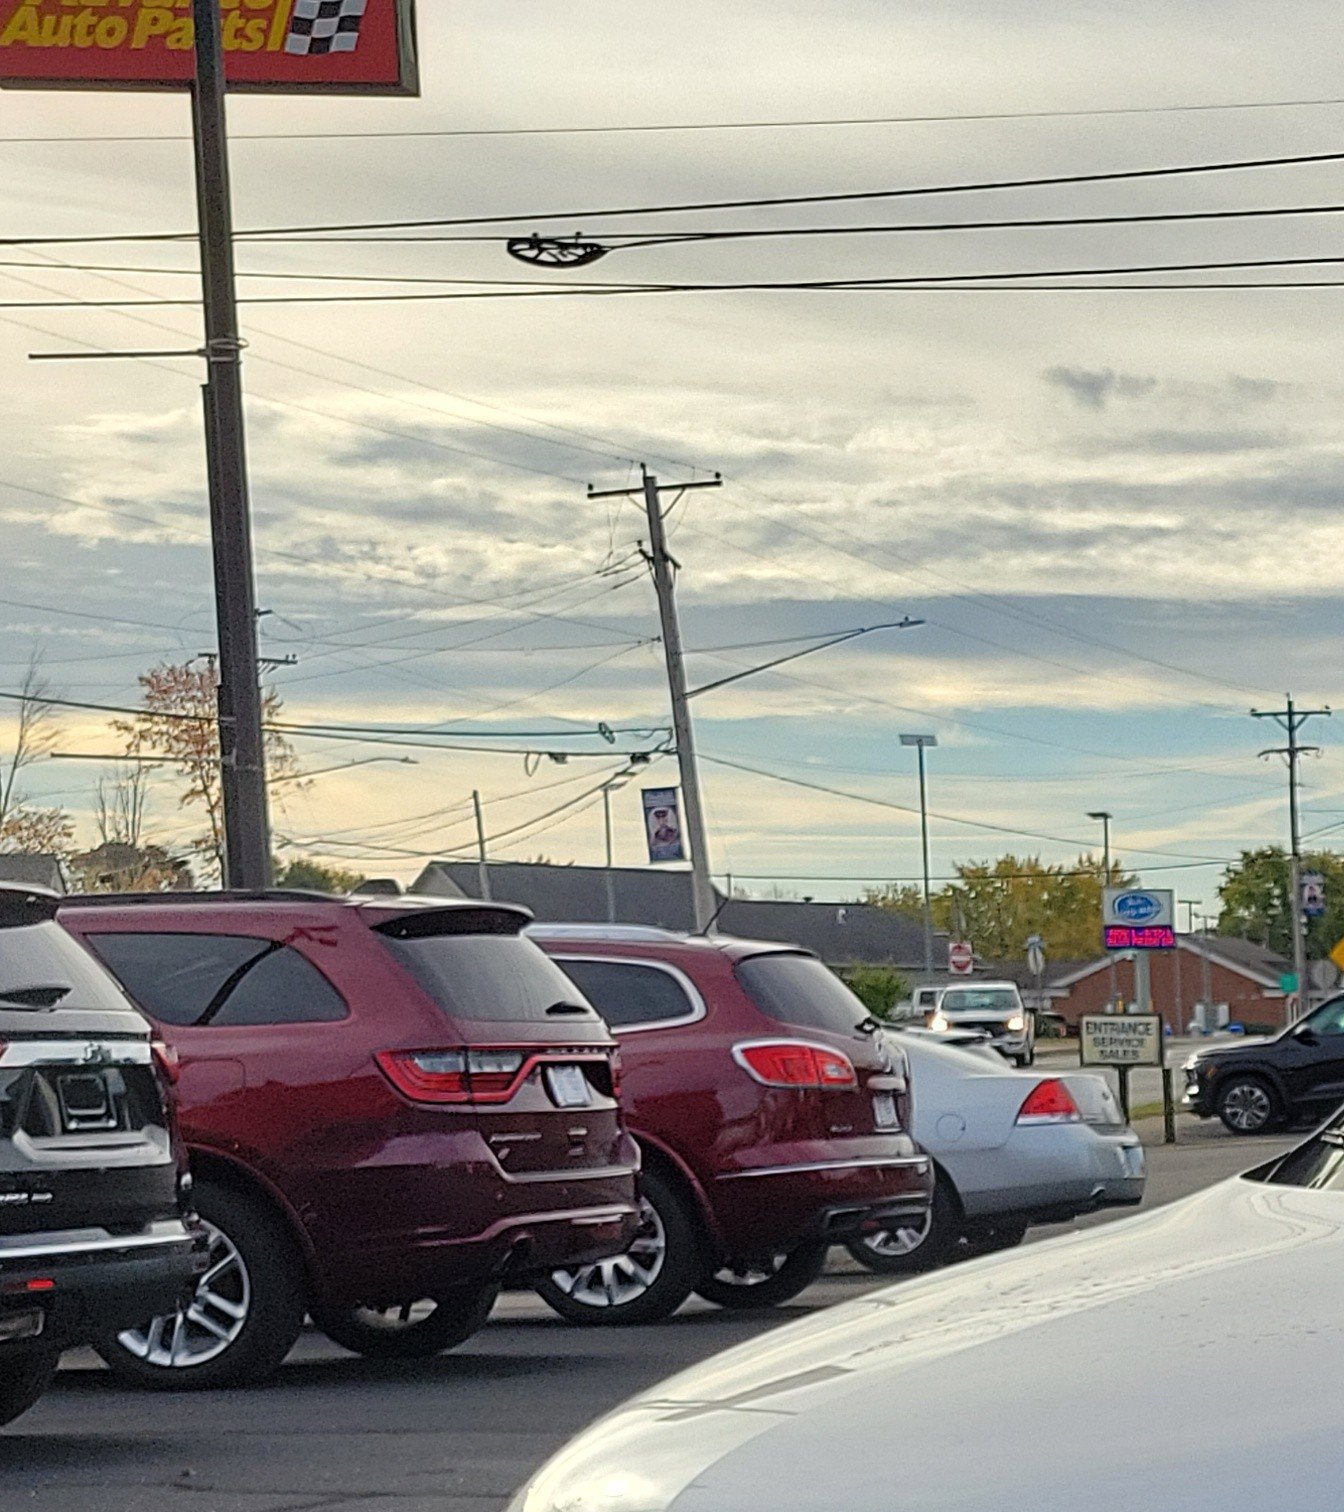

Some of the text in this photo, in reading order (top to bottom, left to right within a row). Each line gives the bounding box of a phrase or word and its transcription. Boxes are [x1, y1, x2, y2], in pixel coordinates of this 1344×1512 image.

[1, 6, 268, 51] Auto Pats
[1086, 1021, 1153, 1035] ENTRANCE
[1092, 1036, 1145, 1048] SERVICE
[1098, 1049, 1140, 1060] SALES
